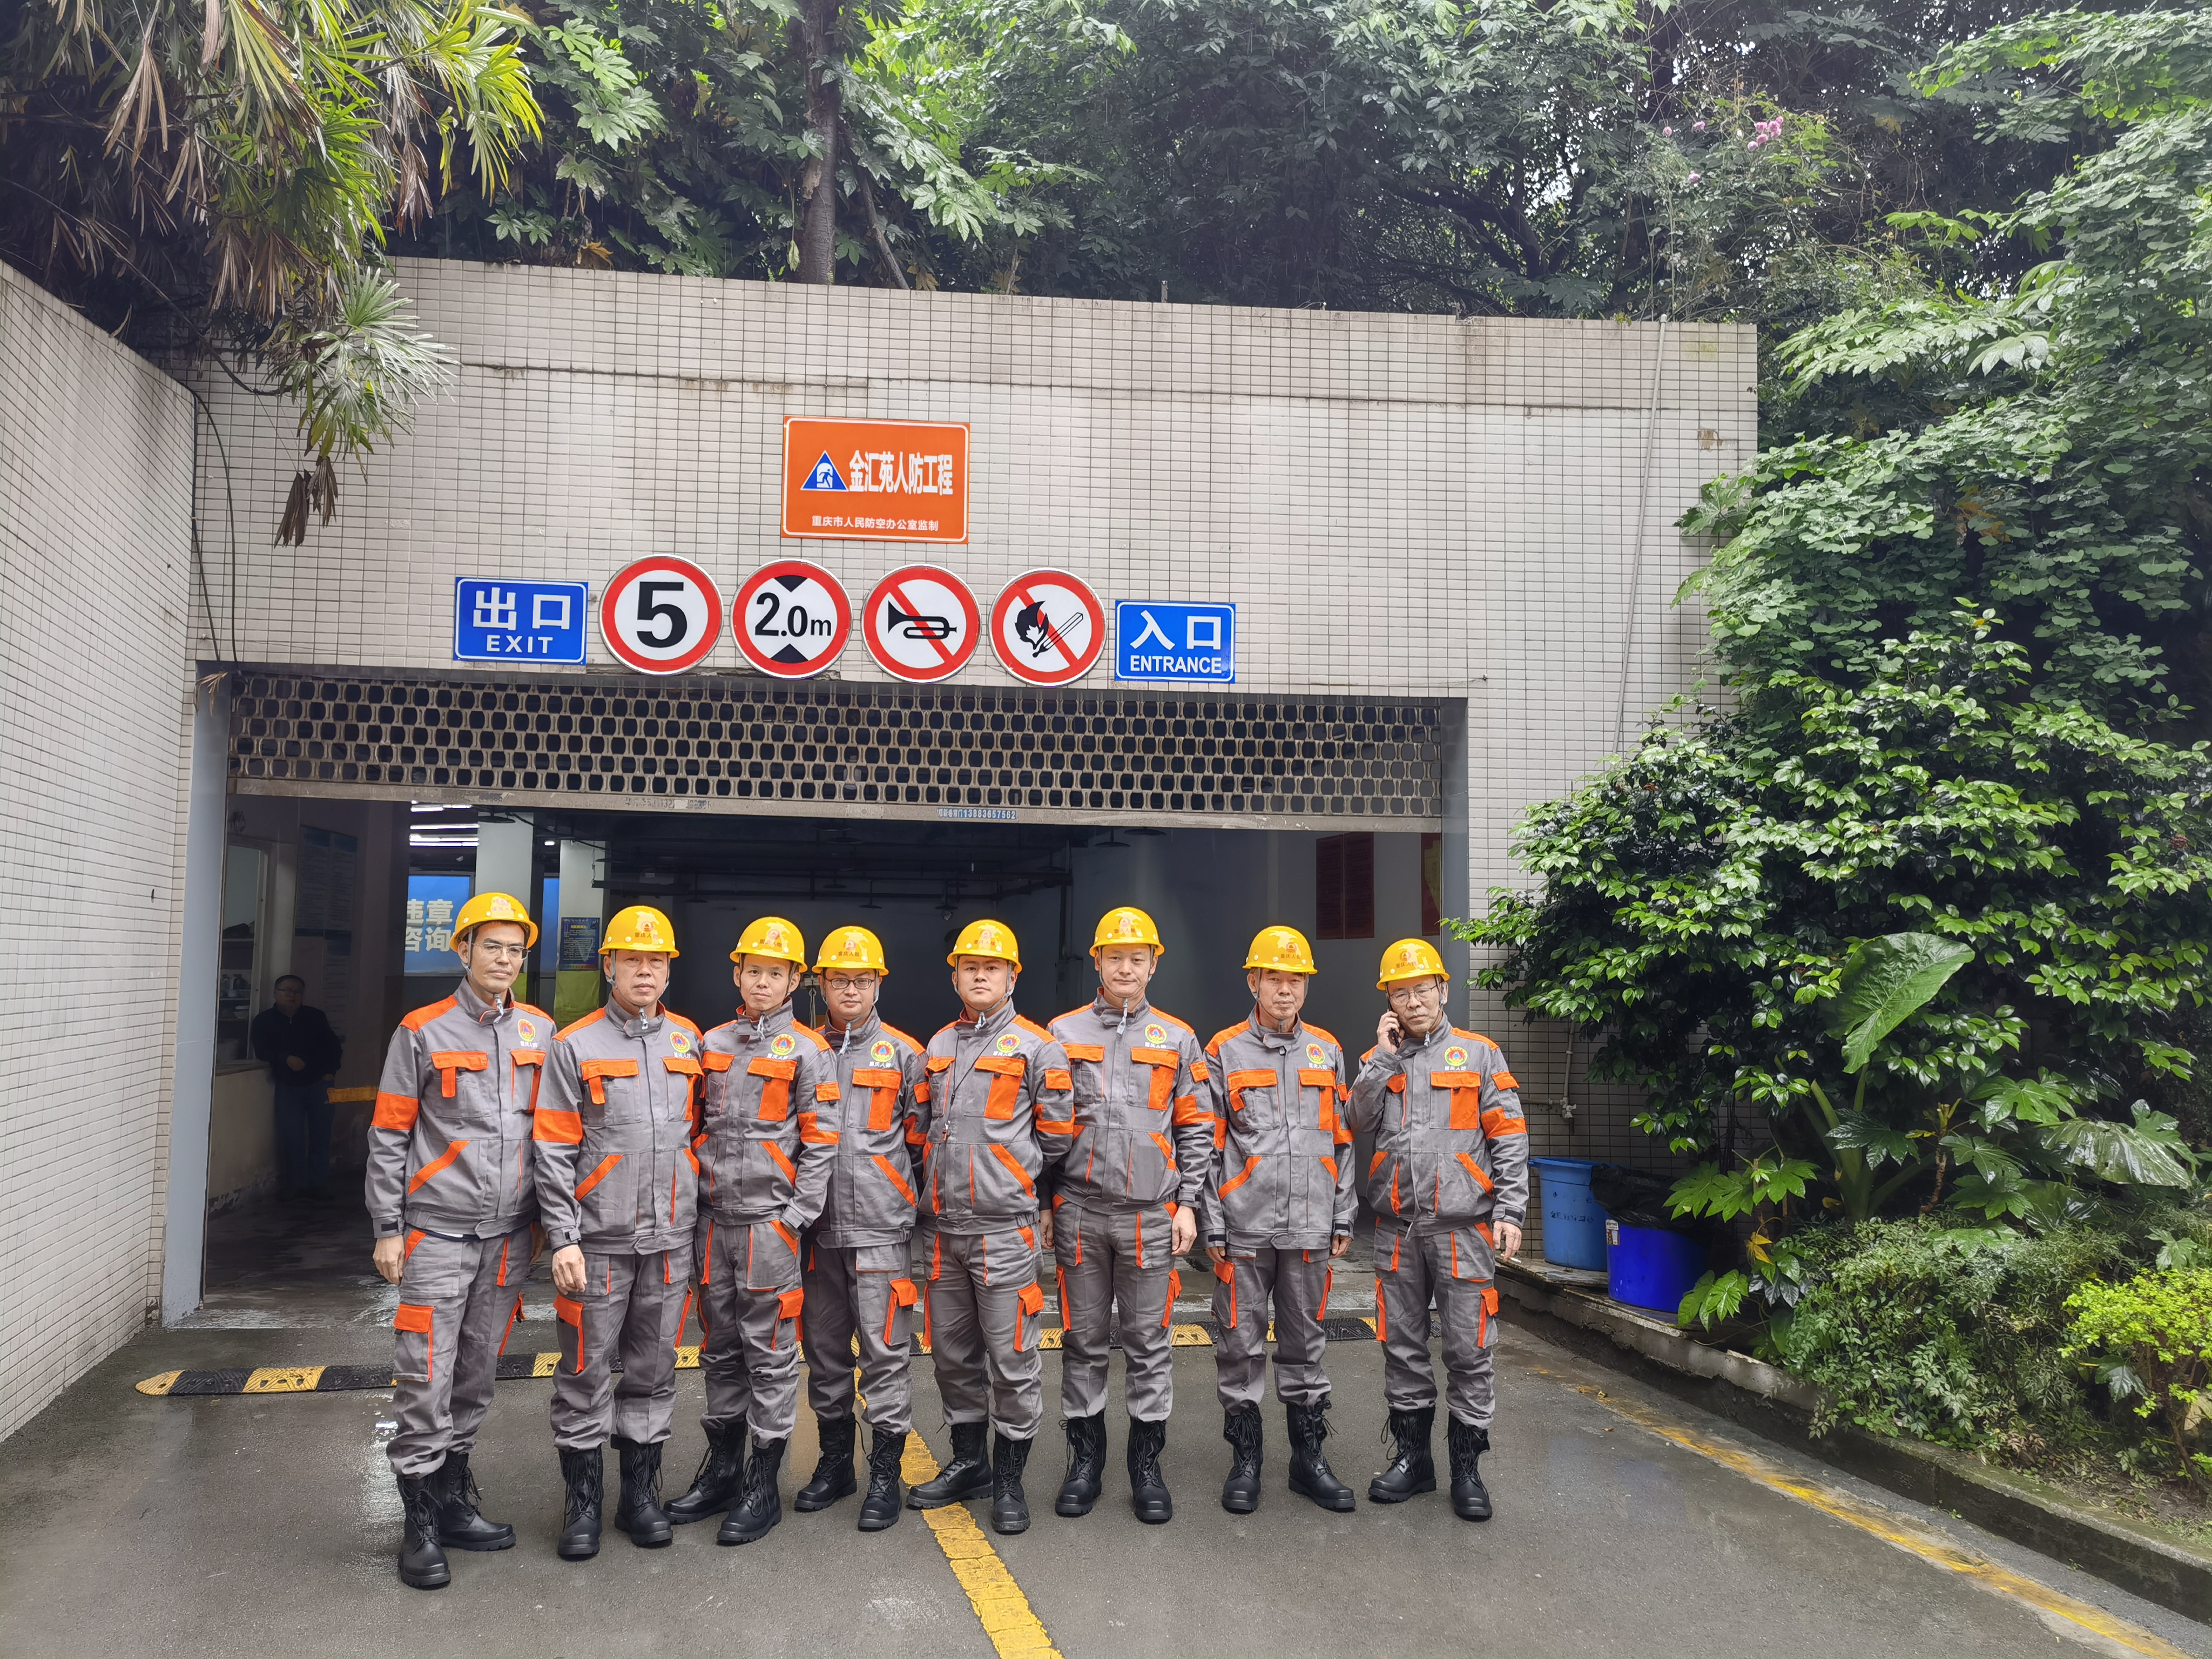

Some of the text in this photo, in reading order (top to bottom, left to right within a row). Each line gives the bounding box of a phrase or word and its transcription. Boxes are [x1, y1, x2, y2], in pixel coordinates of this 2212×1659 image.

[849, 450, 953, 495] 金汇苑人防工程
[812, 516, 939, 531] 重庆市人民防空办公室监制
[473, 587, 570, 631] 出口
[636, 581, 688, 649] 5
[754, 592, 832, 637] 2.0m
[486, 635, 553, 653] EXIT
[1130, 610, 1222, 650] 入口
[1130, 655, 1222, 674] ENTRANCE
[407, 899, 453, 926] 违章
[405, 927, 451, 952] 咨询
